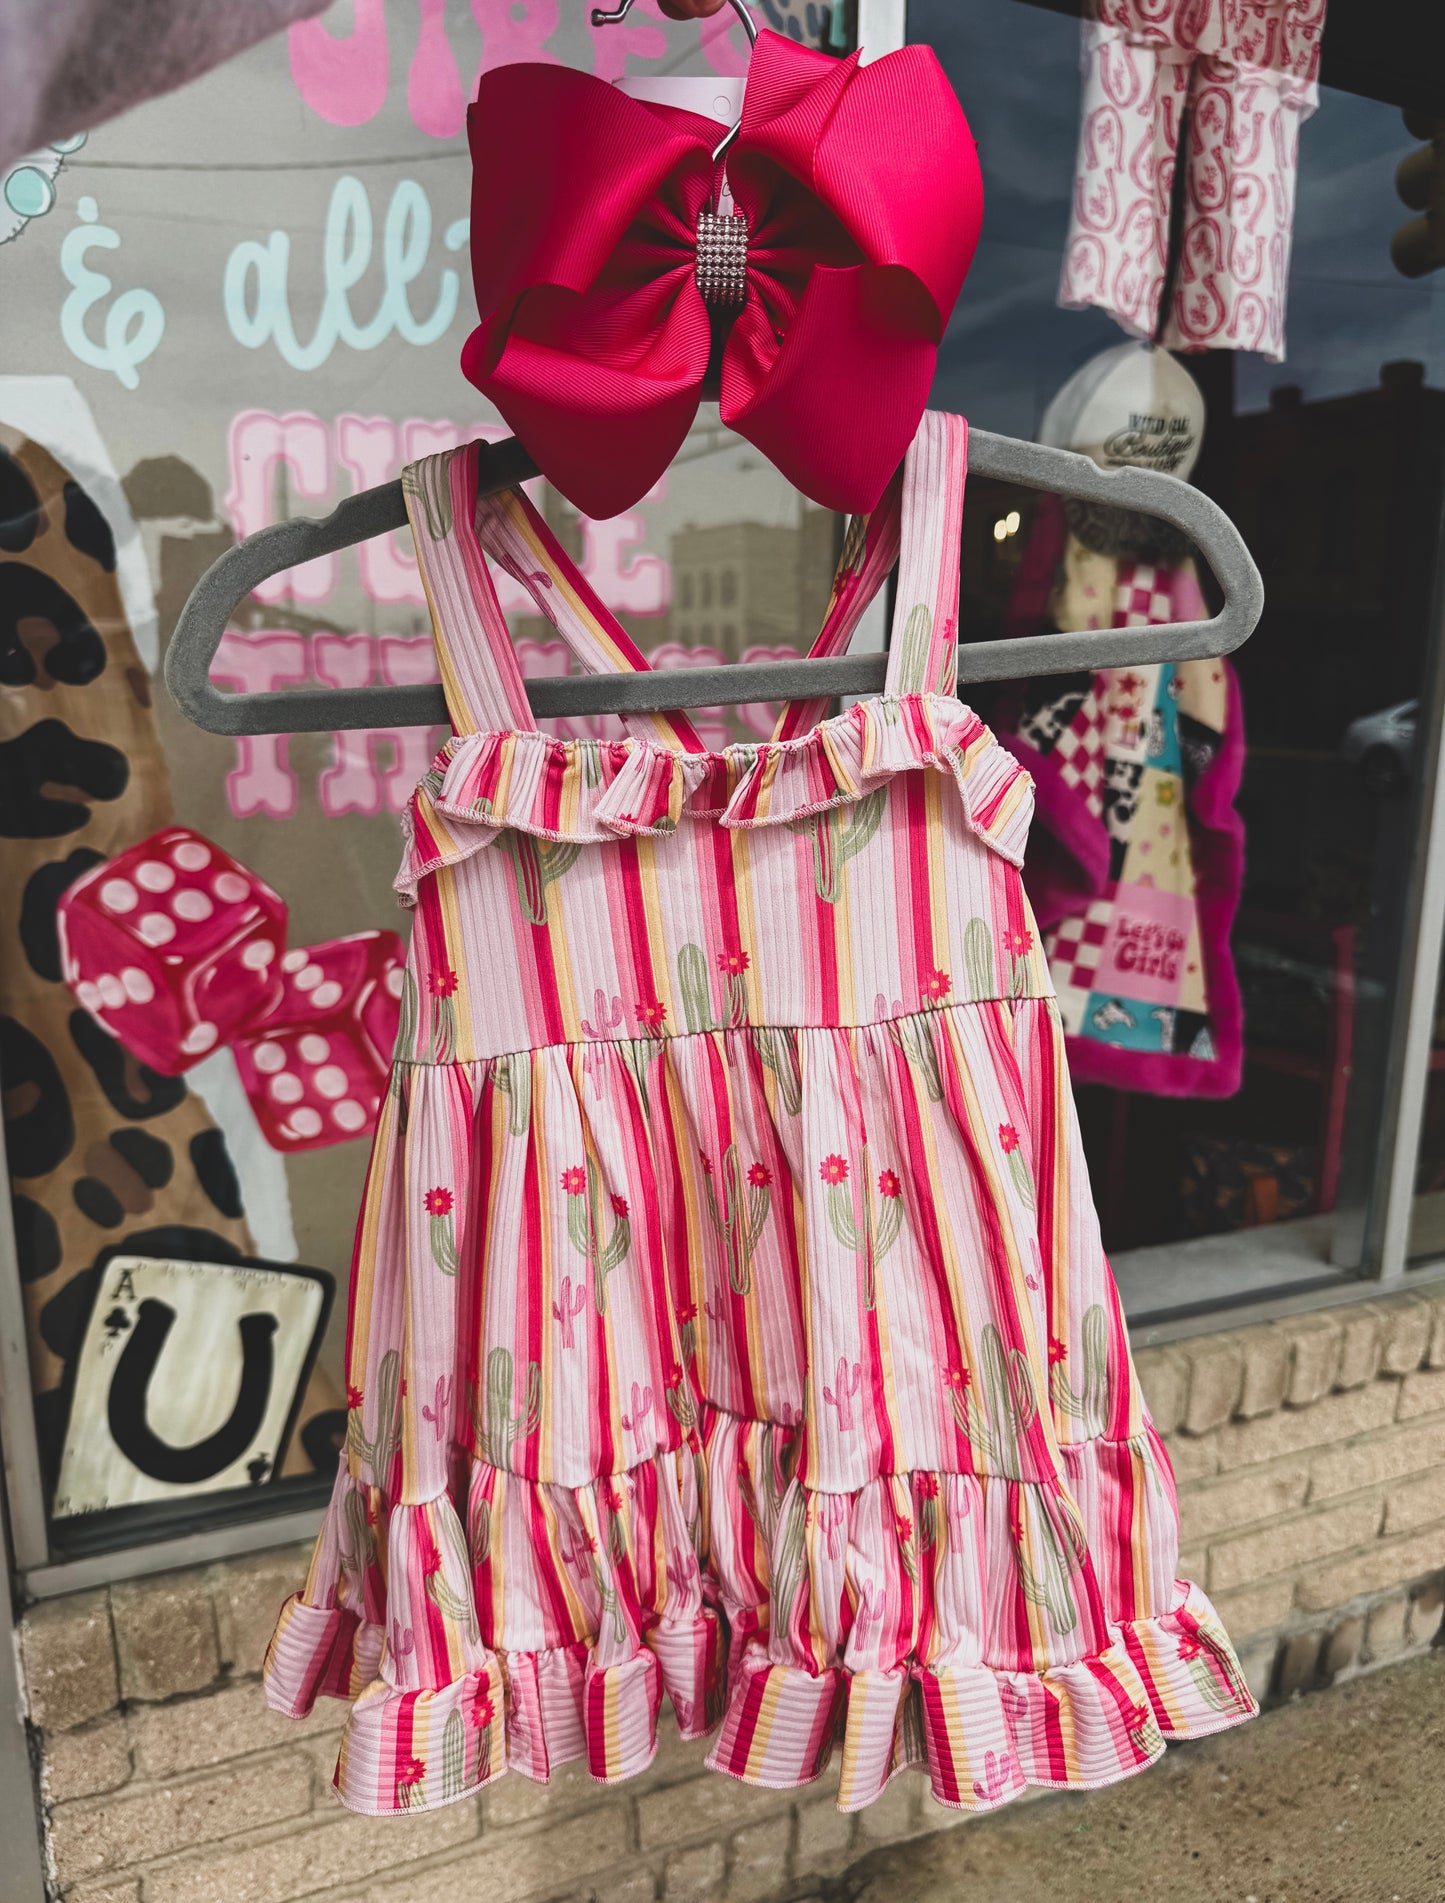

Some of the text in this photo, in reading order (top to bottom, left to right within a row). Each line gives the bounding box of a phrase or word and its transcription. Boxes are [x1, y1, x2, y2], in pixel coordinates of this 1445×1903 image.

[60, 195, 165, 390] &
[1114, 941, 1177, 983] Girls
[111, 1268, 137, 1300] A
